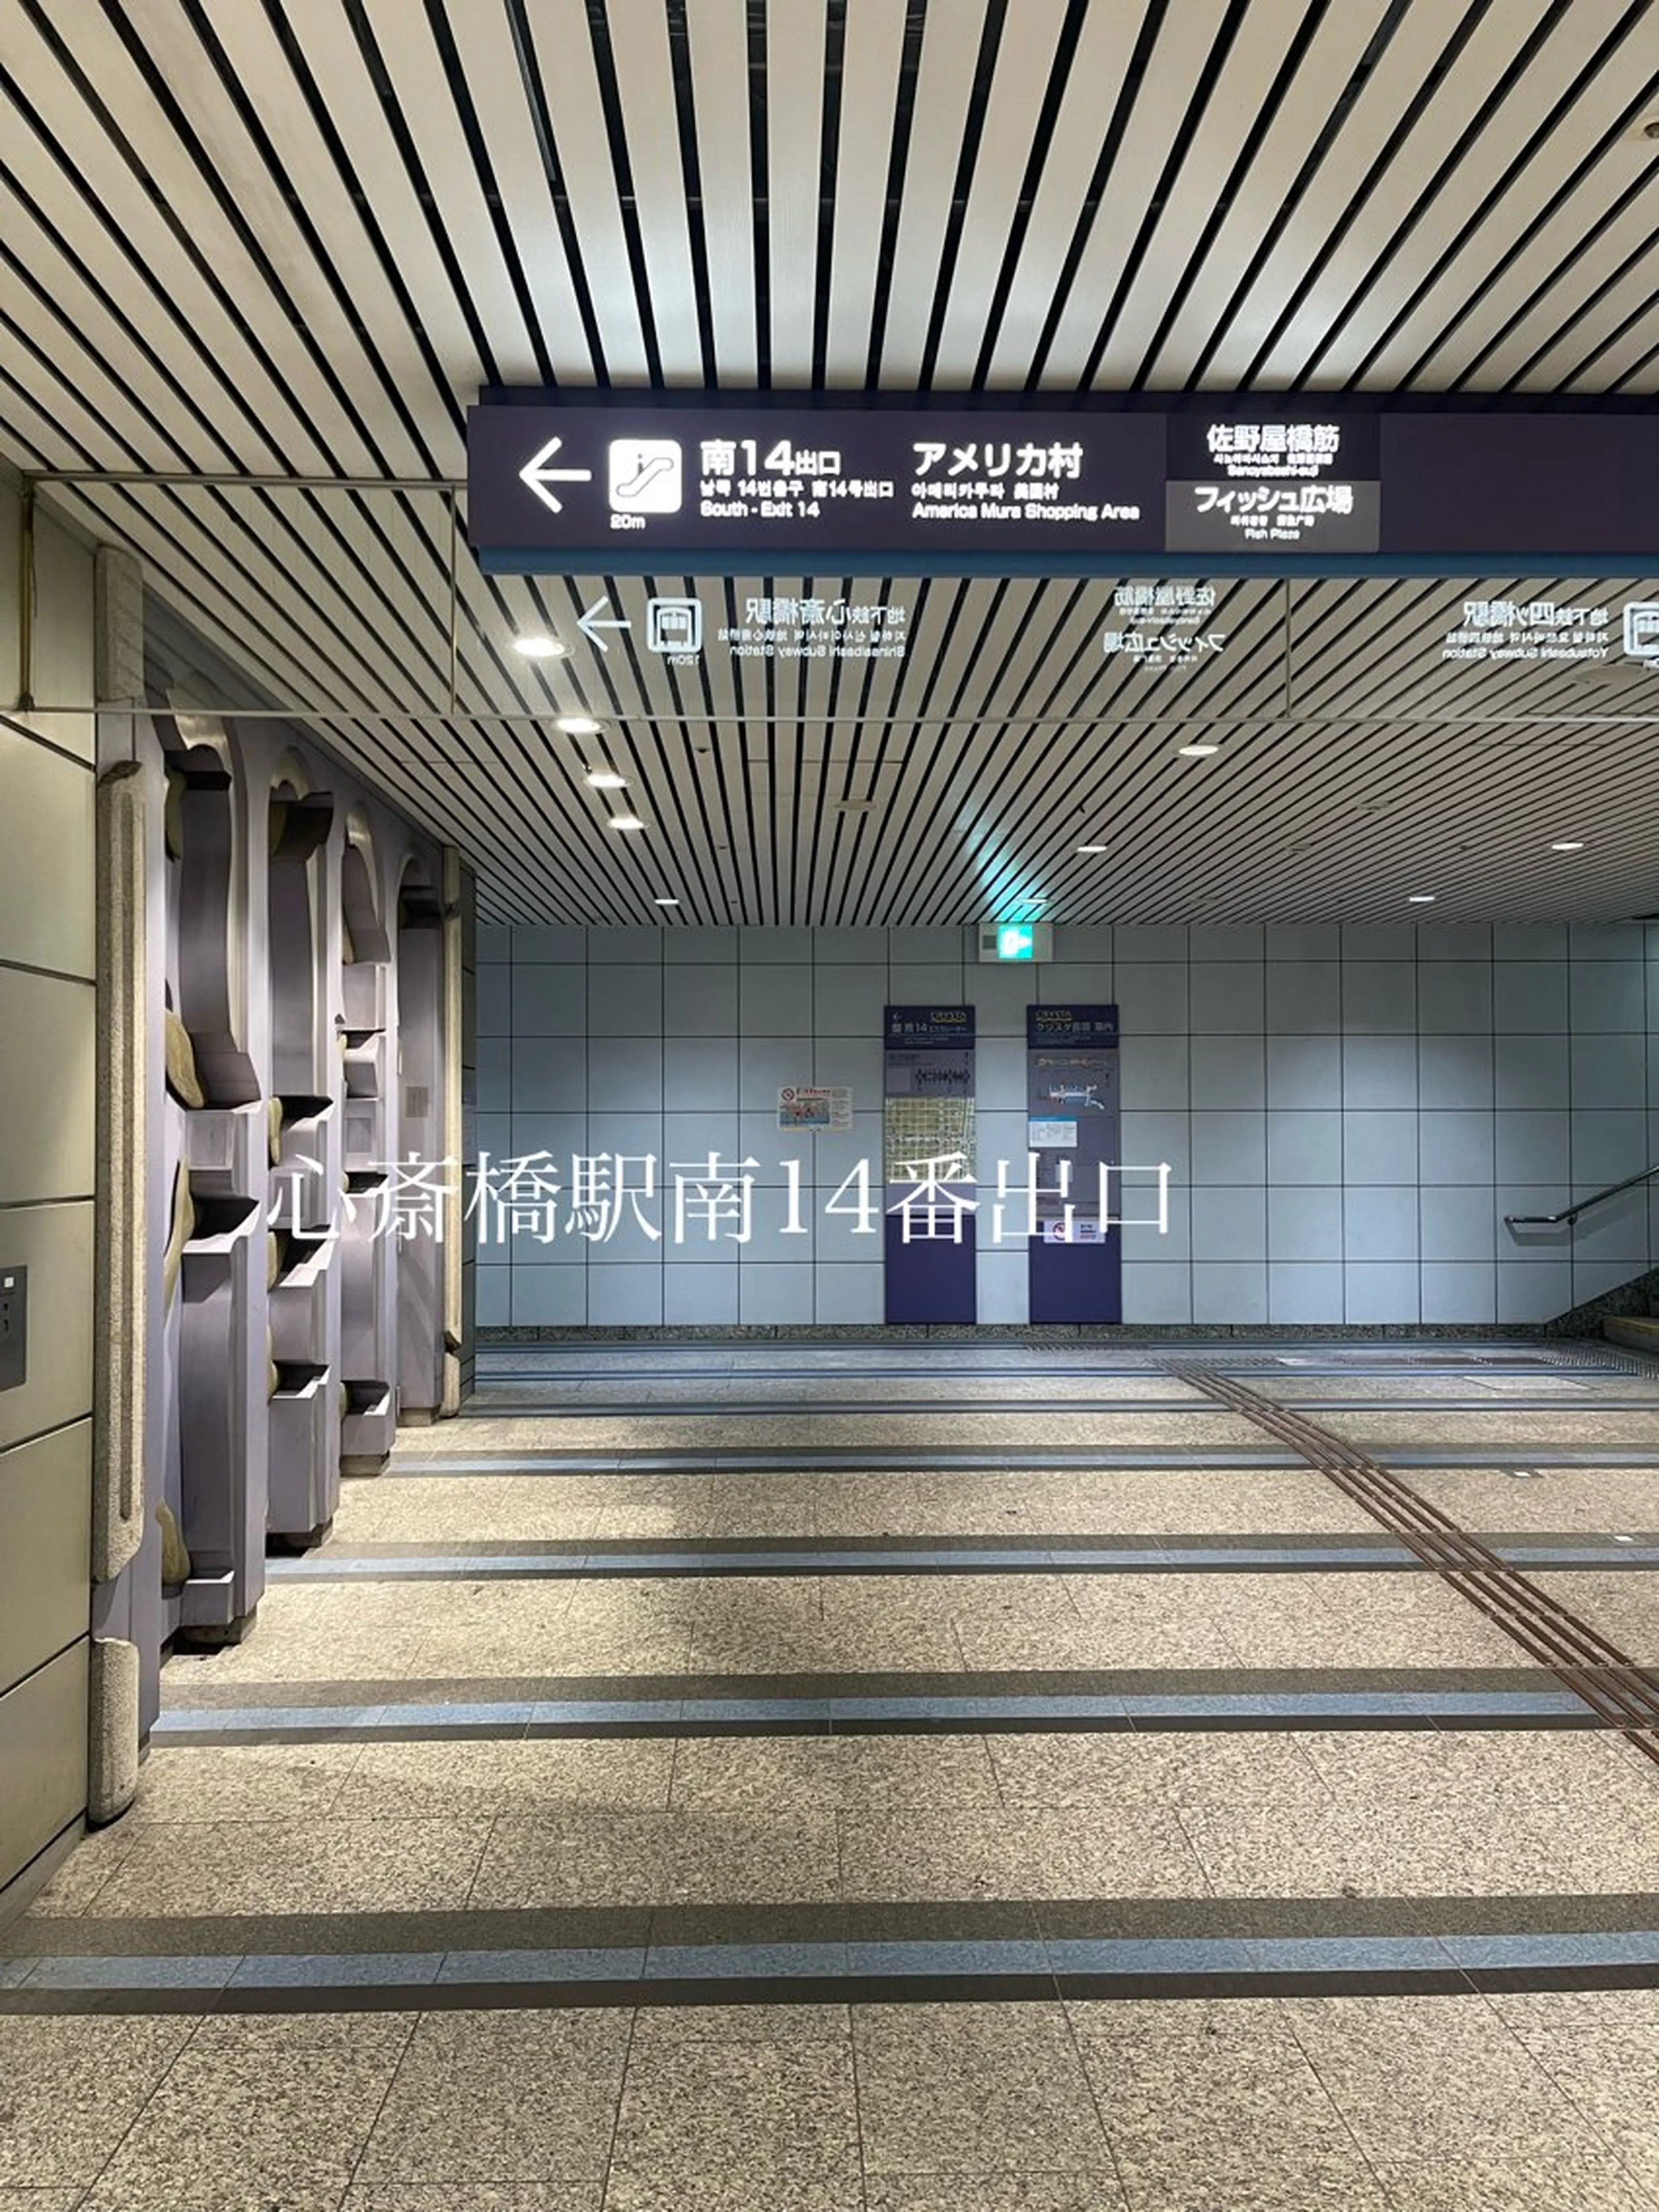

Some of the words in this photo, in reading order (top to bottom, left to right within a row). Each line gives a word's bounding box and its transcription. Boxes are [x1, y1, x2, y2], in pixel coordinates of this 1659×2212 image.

[1207, 424, 1340, 452] 佐野屋橋筋
[700, 439, 840, 476] 南14出口
[913, 442, 1083, 479] アメリカ村
[700, 500, 748, 517] South
[761, 500, 792, 517] Exit
[798, 500, 820, 517] 14
[912, 502, 977, 518] America
[981, 502, 1021, 518] Mura
[1025, 503, 1097, 521] Shopping
[1101, 504, 1140, 519] Area
[1195, 485, 1354, 514] フィッシュ広場
[610, 513, 645, 529] 20m
